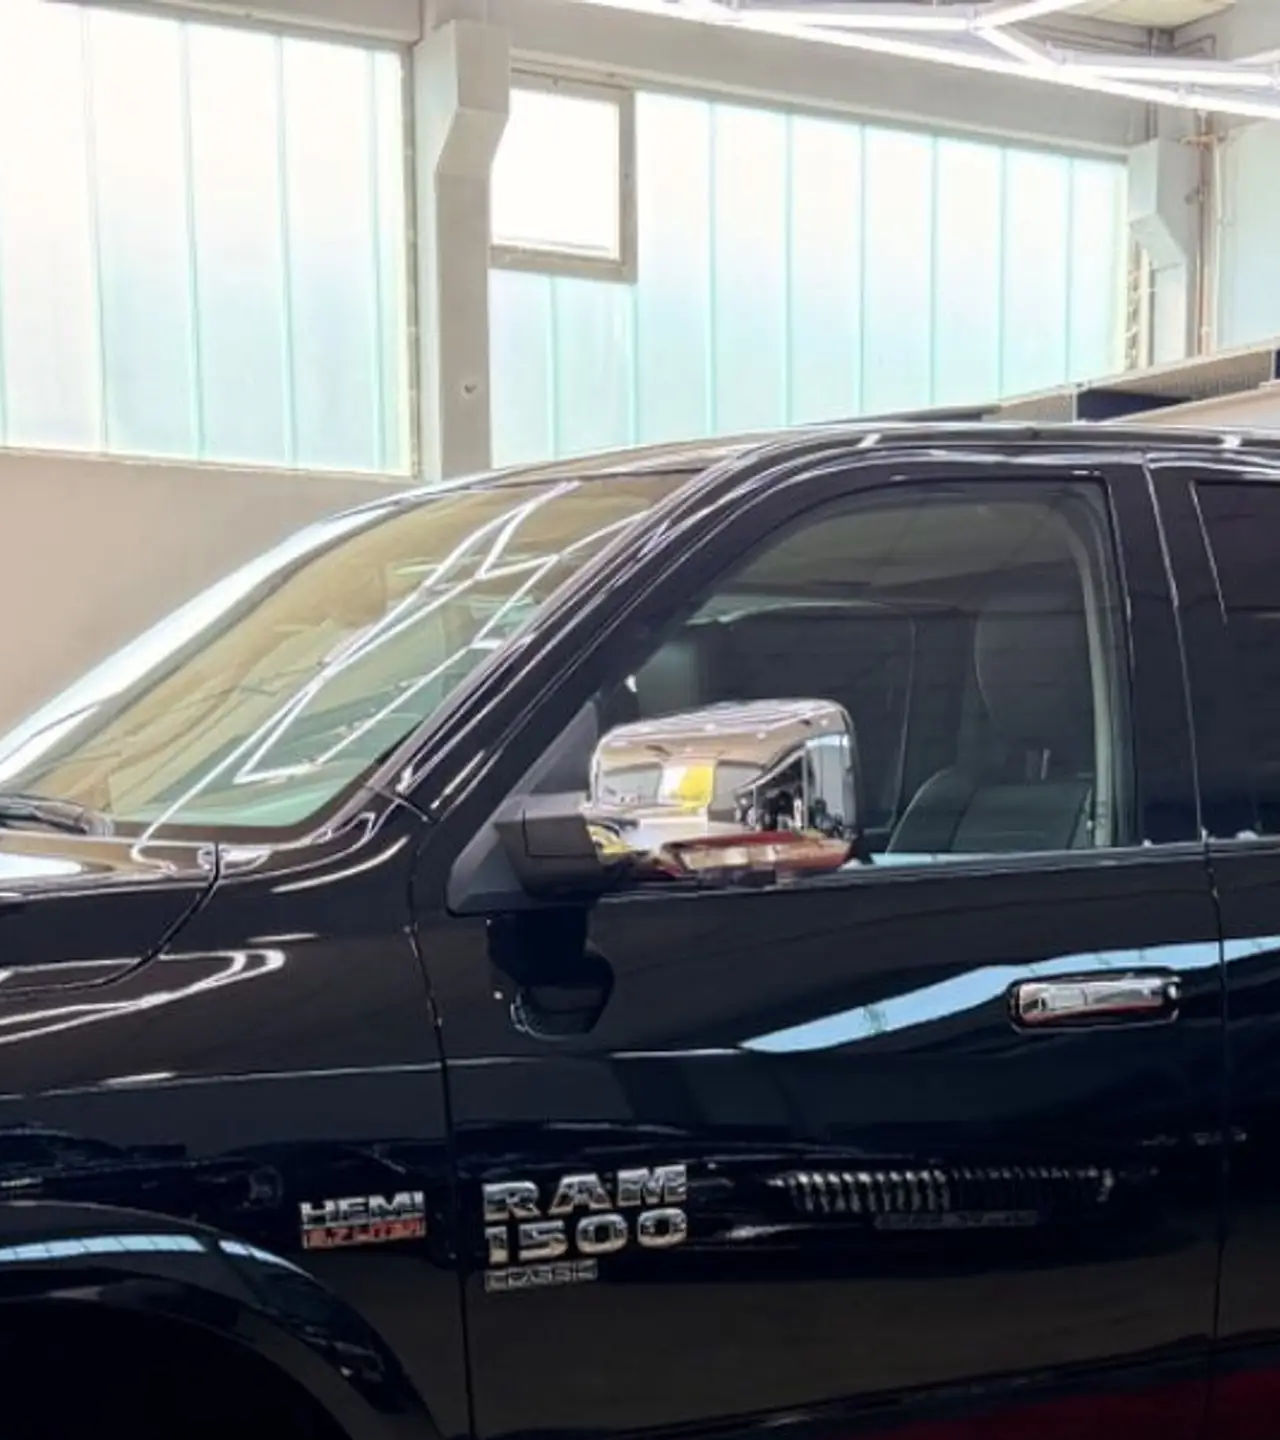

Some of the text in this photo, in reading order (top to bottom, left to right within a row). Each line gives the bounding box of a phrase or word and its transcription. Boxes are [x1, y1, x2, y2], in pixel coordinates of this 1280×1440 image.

[298, 1190, 425, 1227] HEMI
[481, 1163, 688, 1221] RAM
[484, 1207, 688, 1264] 1500
